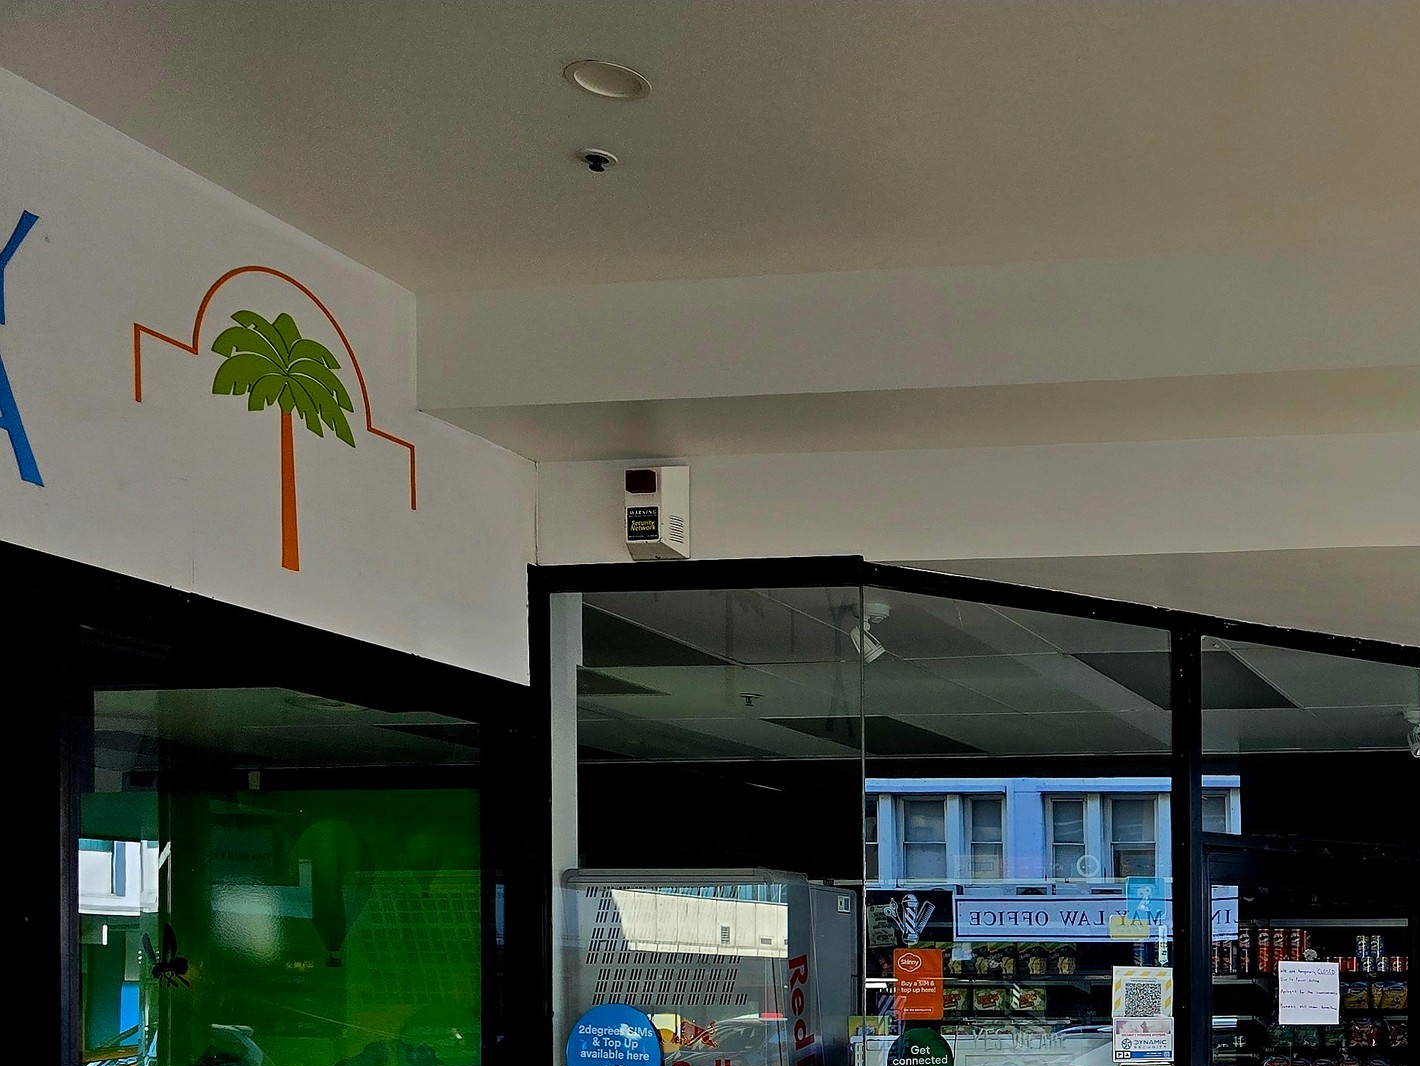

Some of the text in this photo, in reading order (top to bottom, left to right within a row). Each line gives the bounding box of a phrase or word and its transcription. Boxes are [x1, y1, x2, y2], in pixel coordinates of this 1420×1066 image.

[789, 954, 814, 1050] Red
[578, 1024, 653, 1038] 2degrees SIMs
[592, 1038, 638, 1050] & Top Up
[580, 1050, 650, 1061] available here
[910, 1046, 930, 1055] Get
[892, 1054, 948, 1066] connected
